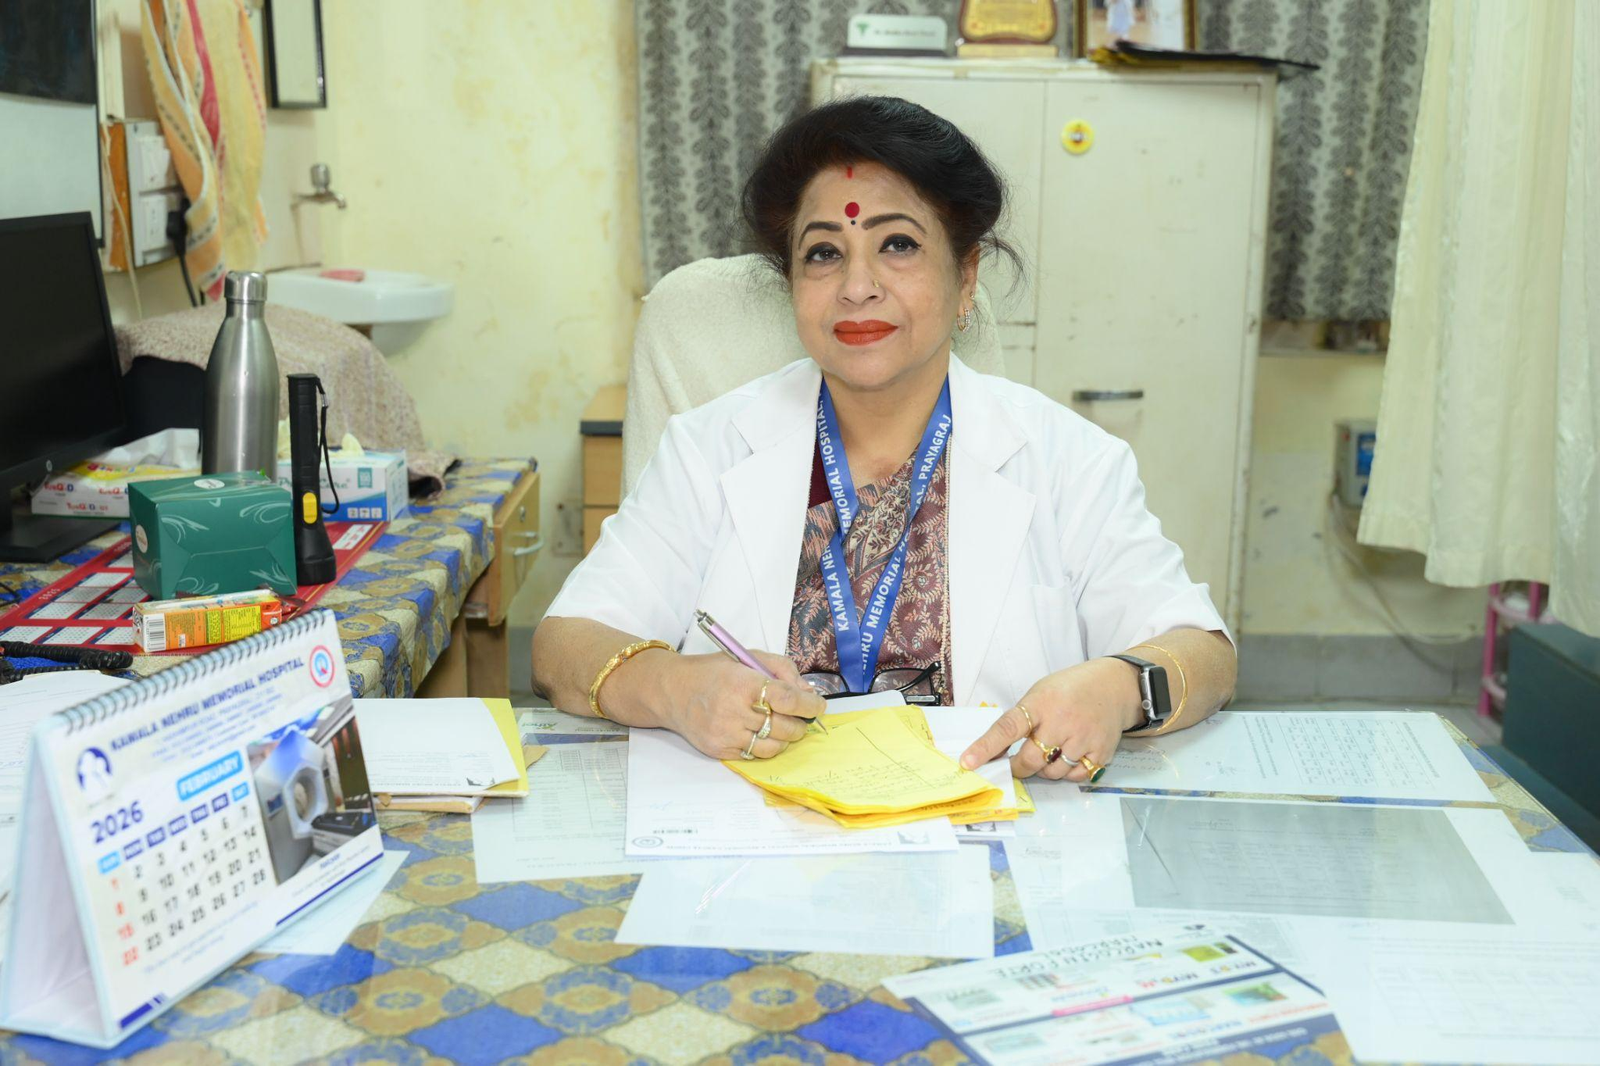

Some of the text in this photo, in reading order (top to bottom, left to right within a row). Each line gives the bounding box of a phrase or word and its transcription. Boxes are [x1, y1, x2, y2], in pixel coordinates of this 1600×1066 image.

[918, 414, 952, 480] PRAYAGRAJ
[829, 572, 849, 632] KAMALA
[111, 722, 158, 751] KAMALA
[161, 702, 199, 728] NEHRU
[202, 680, 256, 711] MEMORIAL
[258, 657, 304, 686] HOSPITAL
[181, 756, 241, 798] FEBRUARY
[91, 800, 144, 844] 2026
